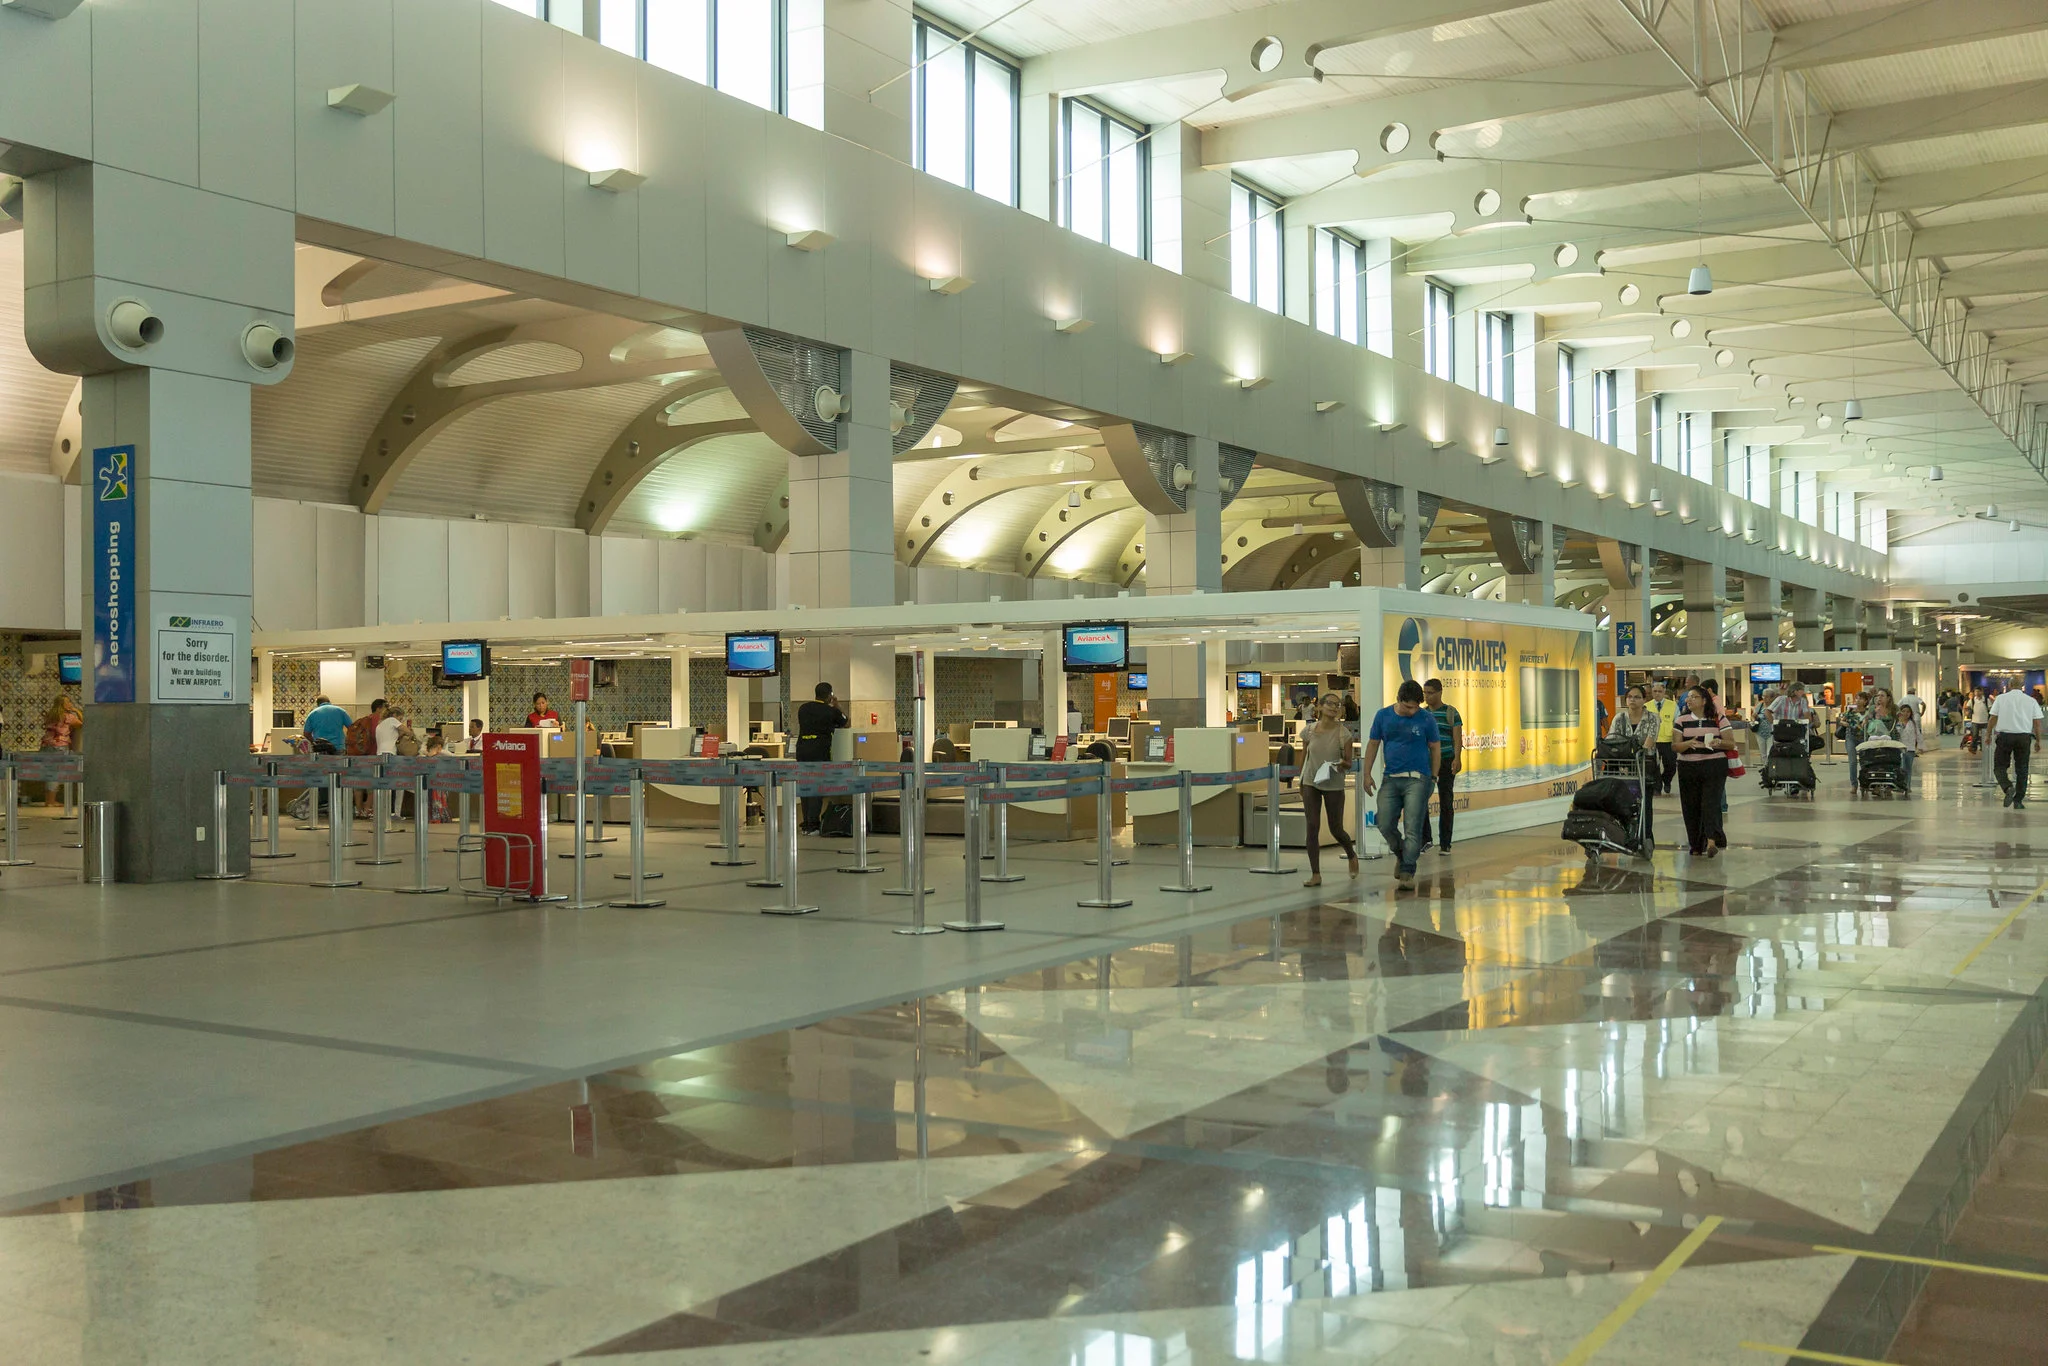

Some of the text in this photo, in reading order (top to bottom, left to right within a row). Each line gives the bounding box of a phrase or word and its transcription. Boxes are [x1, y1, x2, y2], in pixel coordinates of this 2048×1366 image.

[108, 521, 121, 667] aeroshopping
[191, 619, 224, 627] INFRAERO
[186, 637, 208, 650] Sorry
[162, 651, 230, 662] for the disorder.
[1436, 636, 1507, 672] CENTRALTEC
[196, 669, 221, 677] building
[495, 740, 526, 751] Avianca
